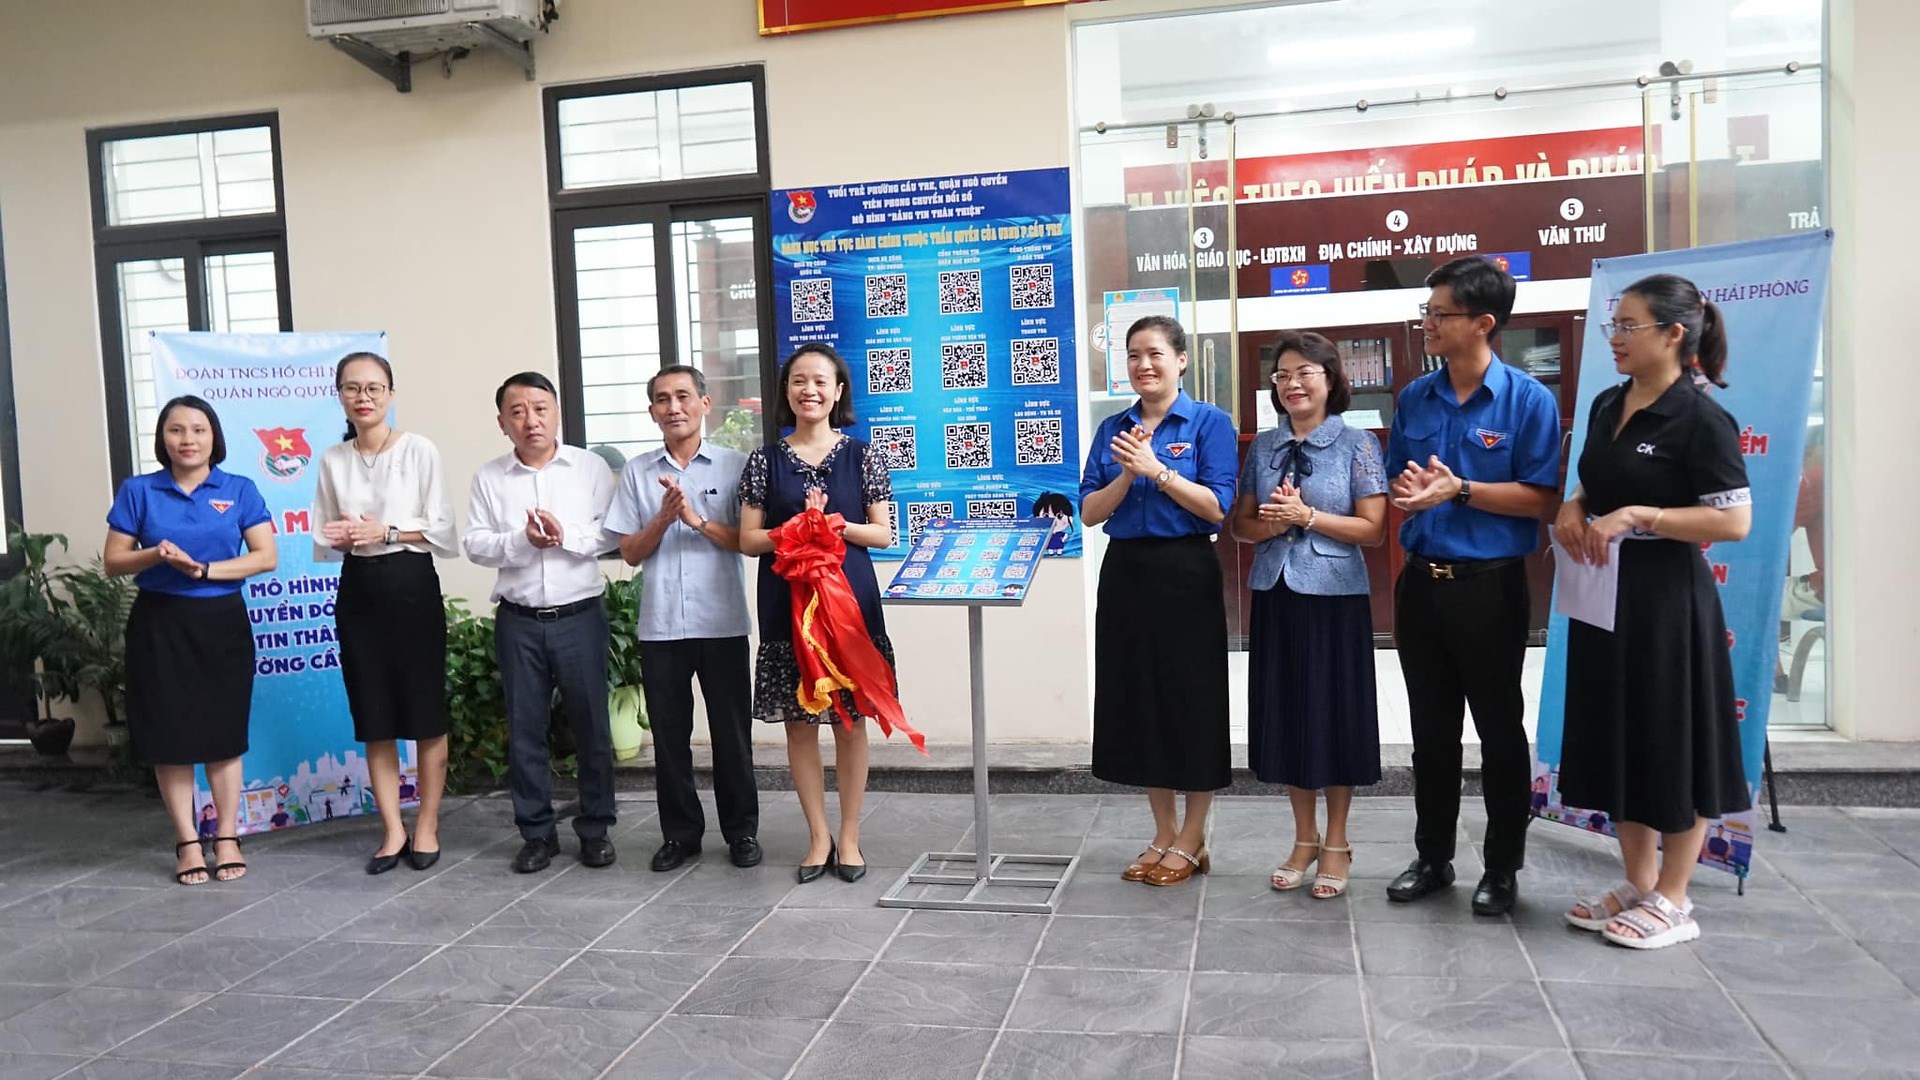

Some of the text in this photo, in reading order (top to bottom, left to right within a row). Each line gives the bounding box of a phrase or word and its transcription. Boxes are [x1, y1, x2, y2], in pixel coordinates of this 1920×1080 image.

[1568, 203, 1575, 215] 5
[1788, 207, 1821, 229] TRẢ
[1393, 215, 1401, 227] 4
[1200, 232, 1207, 244] 3
[1538, 223, 1607, 246] VĂN THƯ
[1318, 244, 1343, 262] ĐỊA
[1347, 236, 1392, 258] CHÍNH
[1403, 235, 1433, 254] XÂY
[1436, 232, 1477, 255] DỰNG
[1136, 254, 1160, 271] VĂN
[1163, 251, 1187, 271] HÓA
[1196, 249, 1224, 268] GIÁO
[1749, 279, 1810, 300] PHÒNG
[228, 367, 268, 379] TNCS
[294, 385, 338, 398] QUYỀ
[1738, 426, 1768, 455] ỂM
[249, 575, 339, 598] MÔ HÌNH
[249, 600, 304, 624] UYỂN
[256, 632, 289, 649] TIN
[254, 648, 340, 675] ỜNG CẦ
